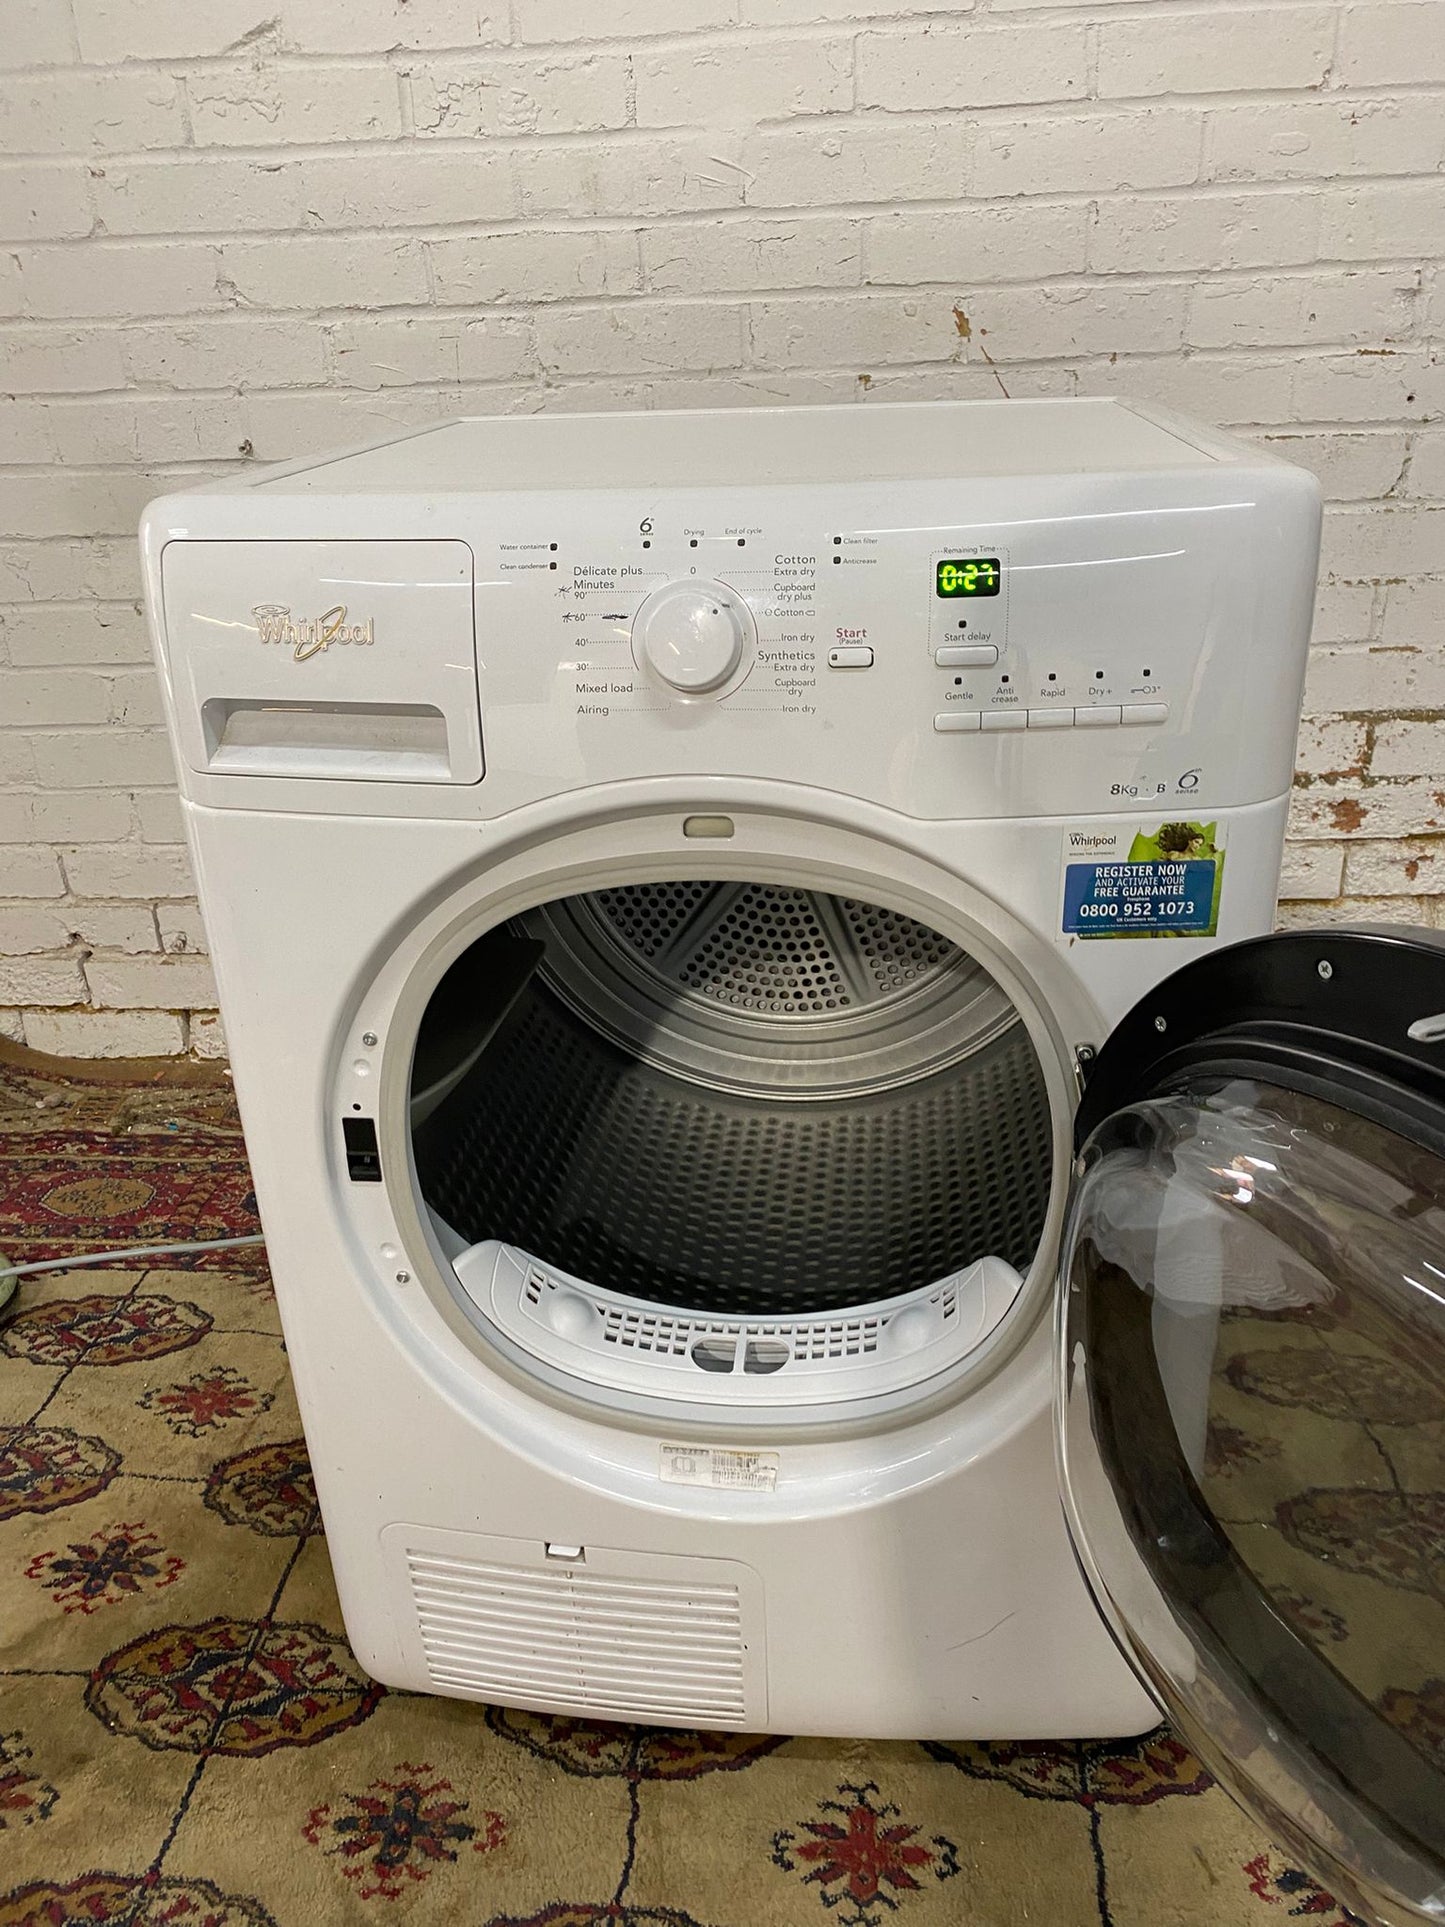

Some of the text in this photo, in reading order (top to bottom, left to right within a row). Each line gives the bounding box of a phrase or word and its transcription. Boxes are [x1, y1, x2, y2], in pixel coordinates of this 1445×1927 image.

[683, 528, 705, 537] Drying
[724, 527, 738, 535] End
[746, 527, 763, 536] cycle
[499, 543, 519, 551] Water
[943, 547, 978, 555] Remaining
[774, 554, 816, 565] Cotton
[573, 565, 643, 578] Délicate plus
[689, 566, 697, 575] 0
[773, 567, 816, 578] Extra dry
[573, 579, 615, 590] Minutes
[773, 582, 816, 593] Cupboard
[776, 592, 812, 602] dry plus
[773, 608, 805, 617] Cotton
[256, 614, 375, 652] Whirlpool
[781, 633, 815, 643] Iron dry
[836, 627, 868, 639] Start
[944, 631, 991, 642] Start delay
[838, 638, 863, 646] (Pause)
[757, 650, 816, 663] Synthetics
[773, 662, 816, 673] Extra dry
[575, 682, 633, 693] Mixed load
[774, 678, 816, 689] Cupboard
[787, 687, 804, 698] dry
[944, 691, 974, 701] Gentle
[995, 686, 1014, 696] Anti
[1040, 688, 1066, 699] Rapid
[991, 695, 1019, 703] crease
[576, 704, 609, 717] Airing
[782, 704, 817, 715] Iron dry
[1110, 783, 1166, 797] 8Kg B
[1069, 835, 1117, 848] Whirlpool
[1095, 864, 1187, 878] REGISTER NOW
[1095, 875, 1185, 887] AND ACTIVATE YOUR
[1094, 885, 1185, 898] FREE GUARANTEE
[1079, 901, 1195, 918] 0800 952 1073
